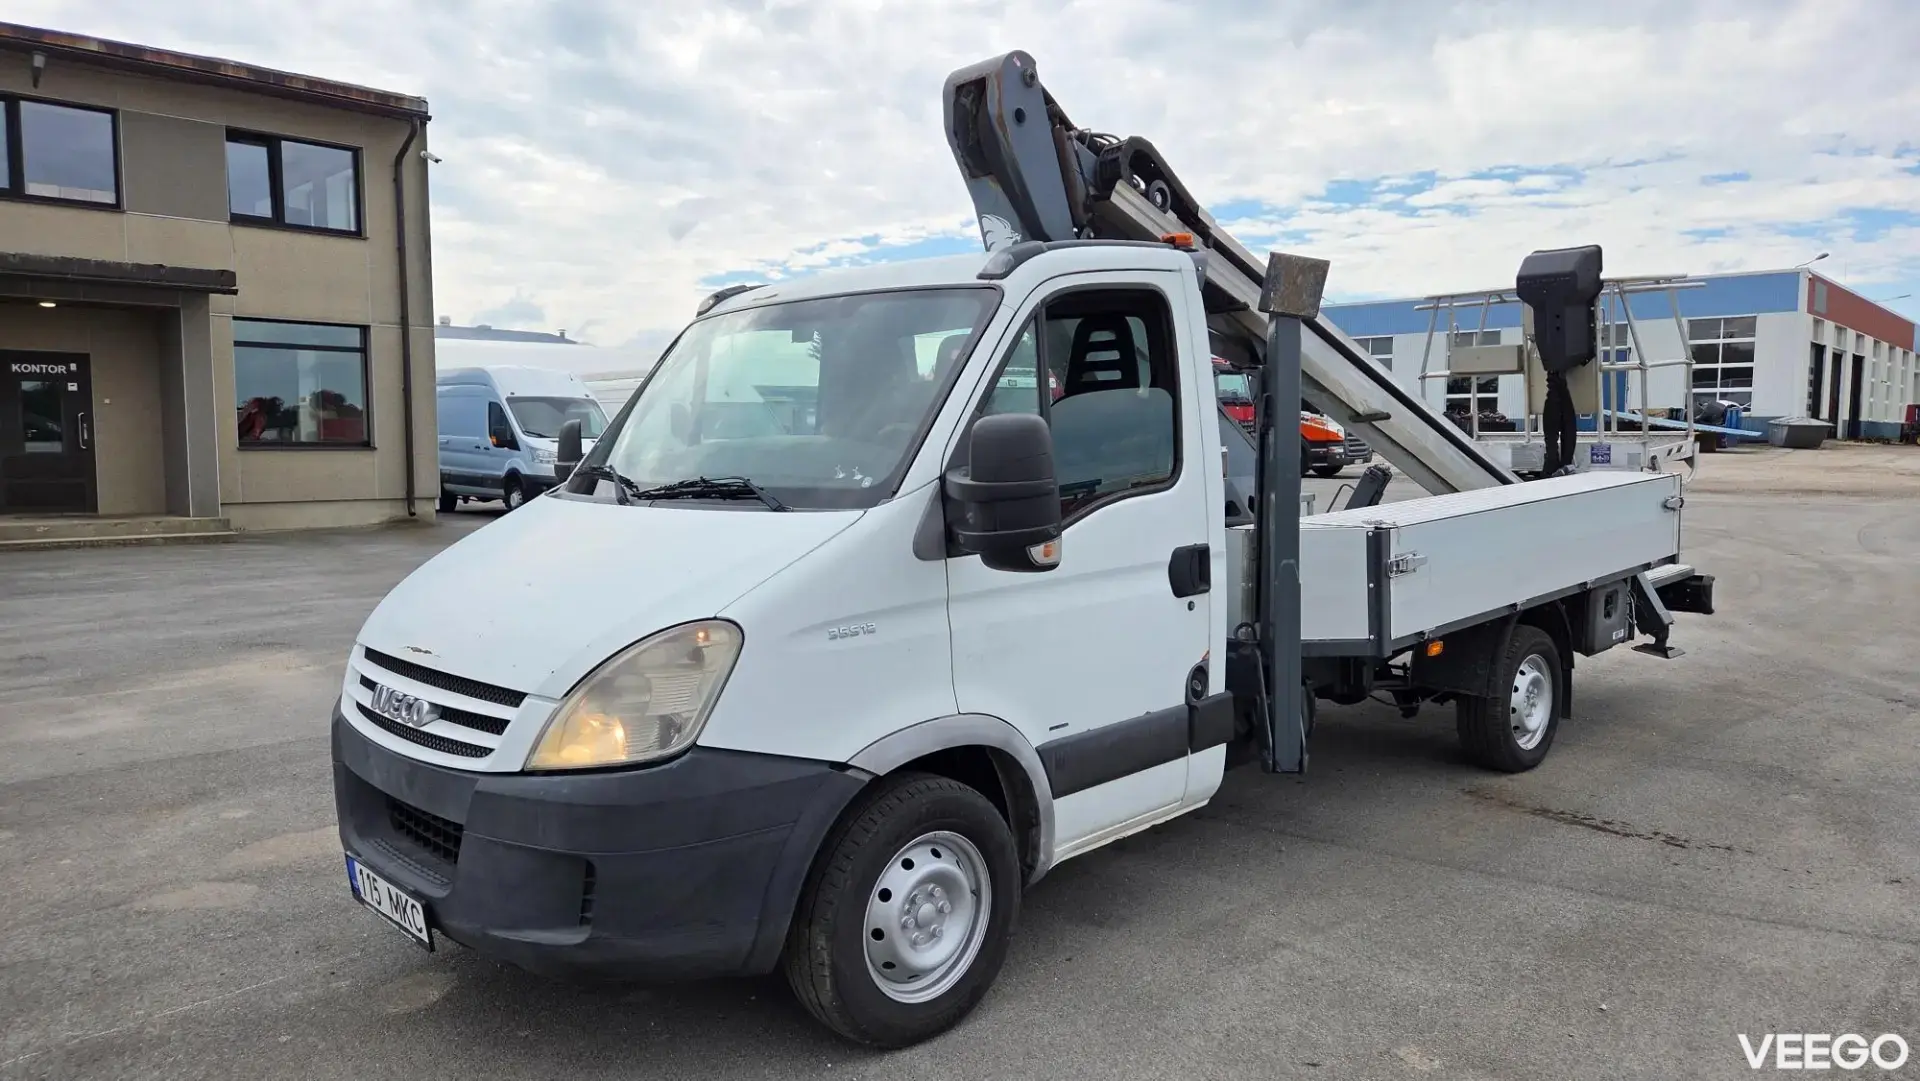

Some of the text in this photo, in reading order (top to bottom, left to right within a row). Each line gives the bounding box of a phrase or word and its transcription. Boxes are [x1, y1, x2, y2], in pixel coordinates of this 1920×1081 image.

[11, 363, 67, 374] KONTOR
[371, 683, 430, 728] IVECO
[359, 868, 381, 907] 115
[387, 886, 423, 934] MKC
